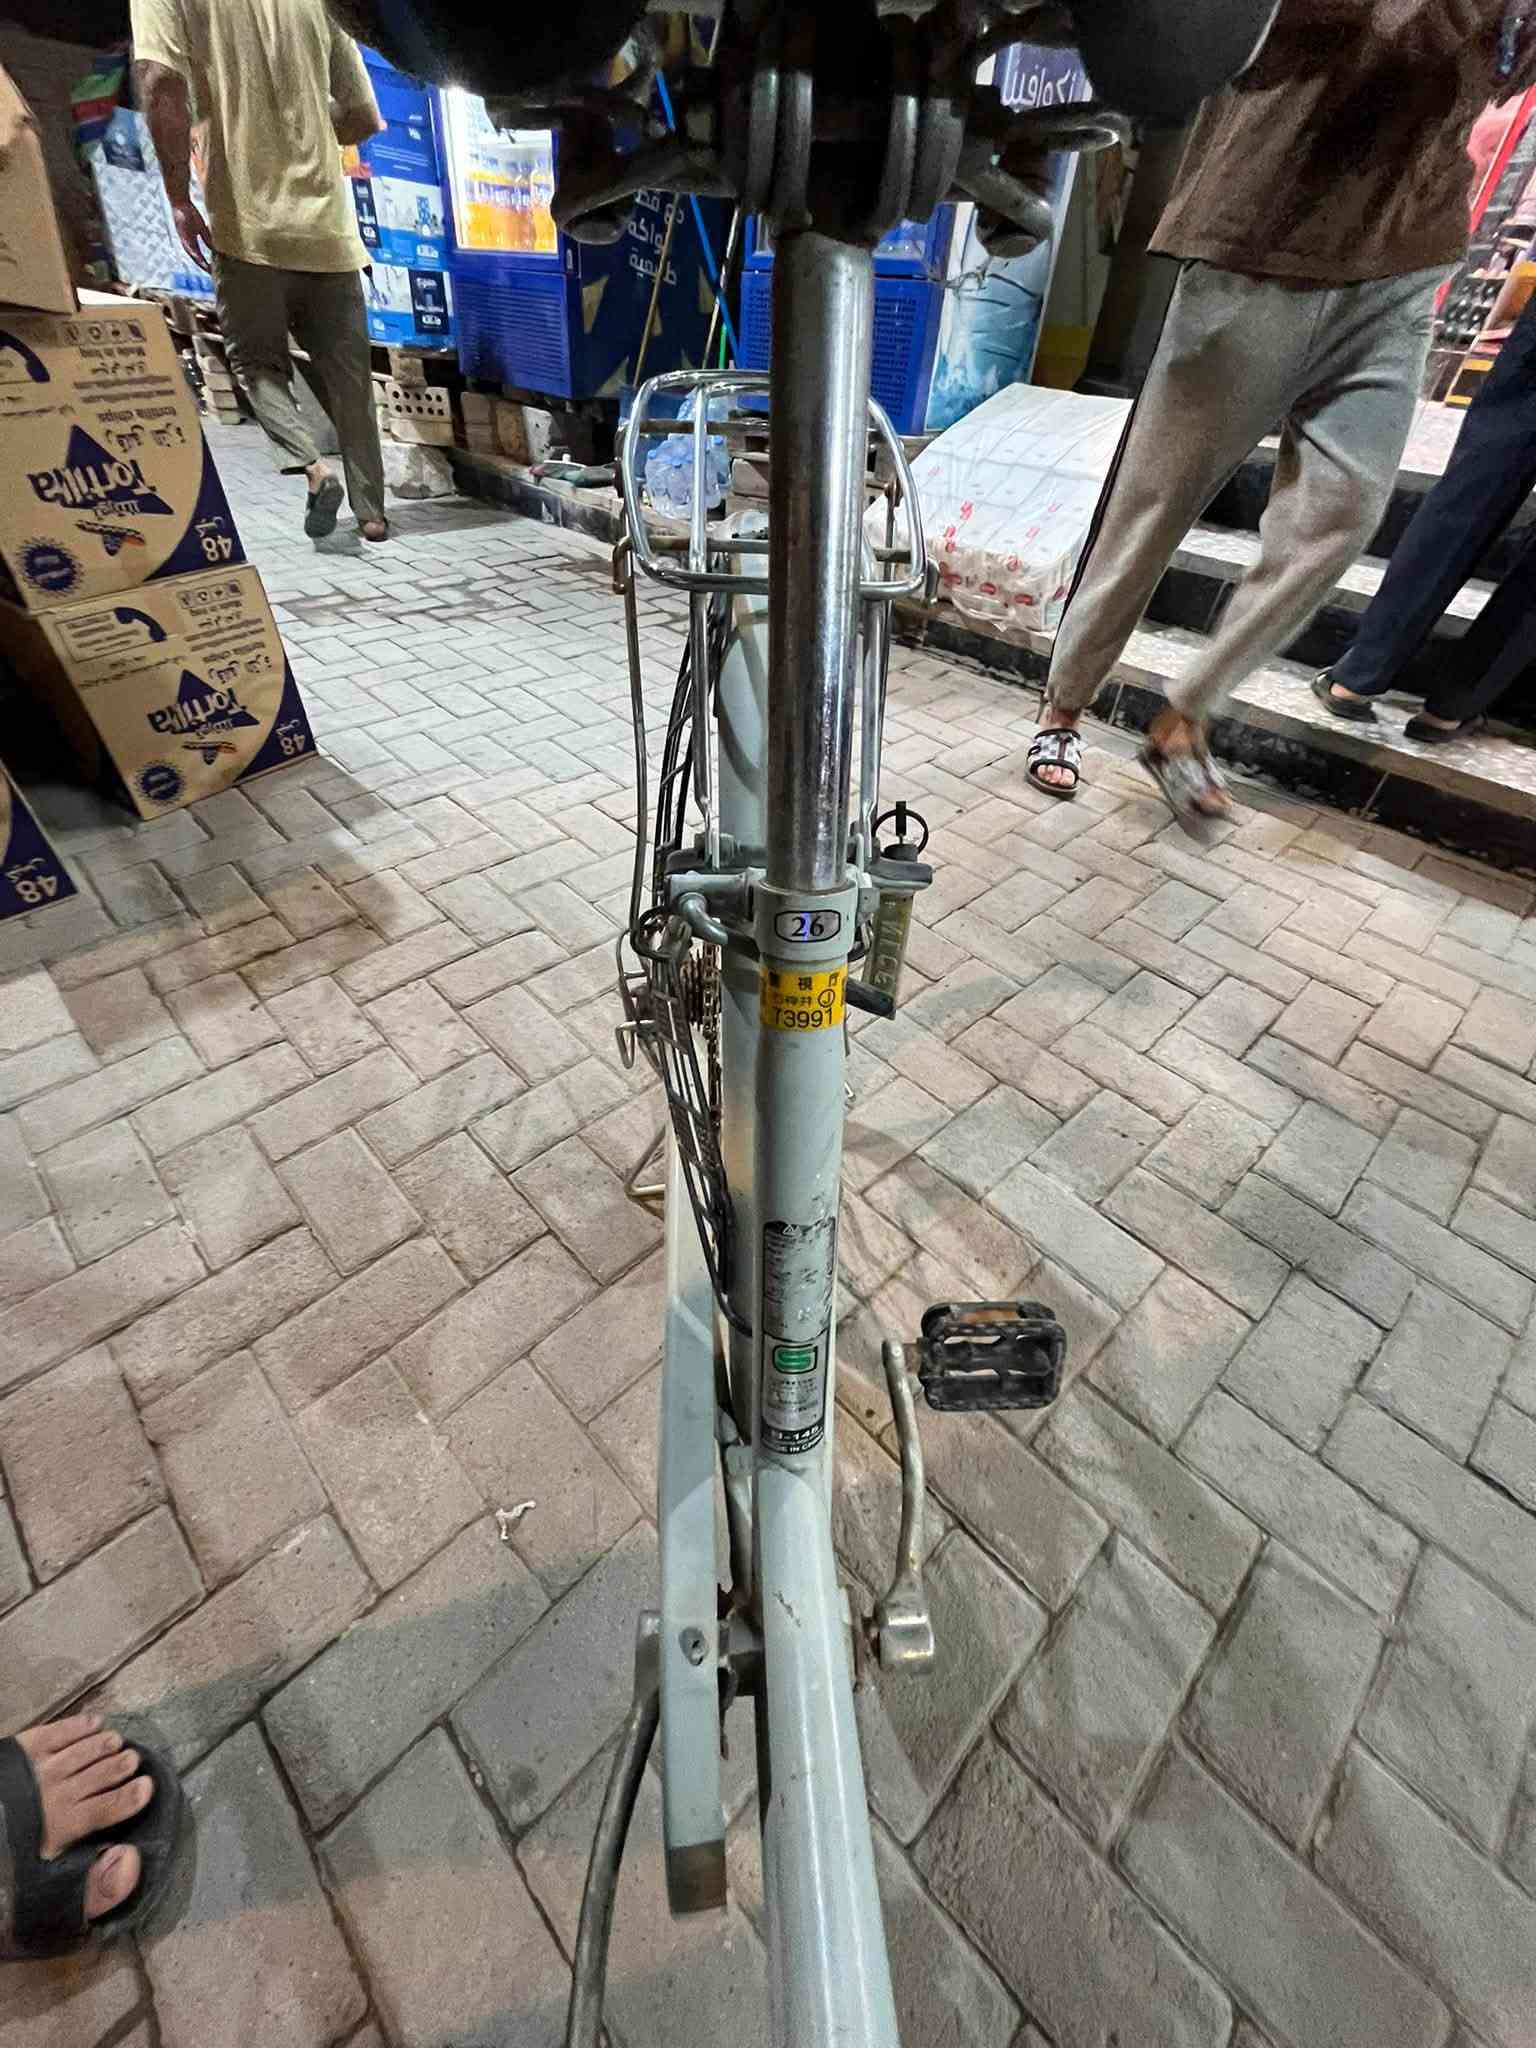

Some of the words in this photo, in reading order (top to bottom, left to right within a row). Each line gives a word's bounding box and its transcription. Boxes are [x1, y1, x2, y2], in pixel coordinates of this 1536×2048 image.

[628, 217, 668, 256] واكه
[629, 247, 678, 286] طيعية
[27, 459, 158, 504] Tortilla
[201, 535, 233, 563] 48
[147, 688, 251, 735] Tortilla
[279, 733, 306, 756] 48
[15, 874, 59, 904] 48
[791, 915, 825, 938] 26
